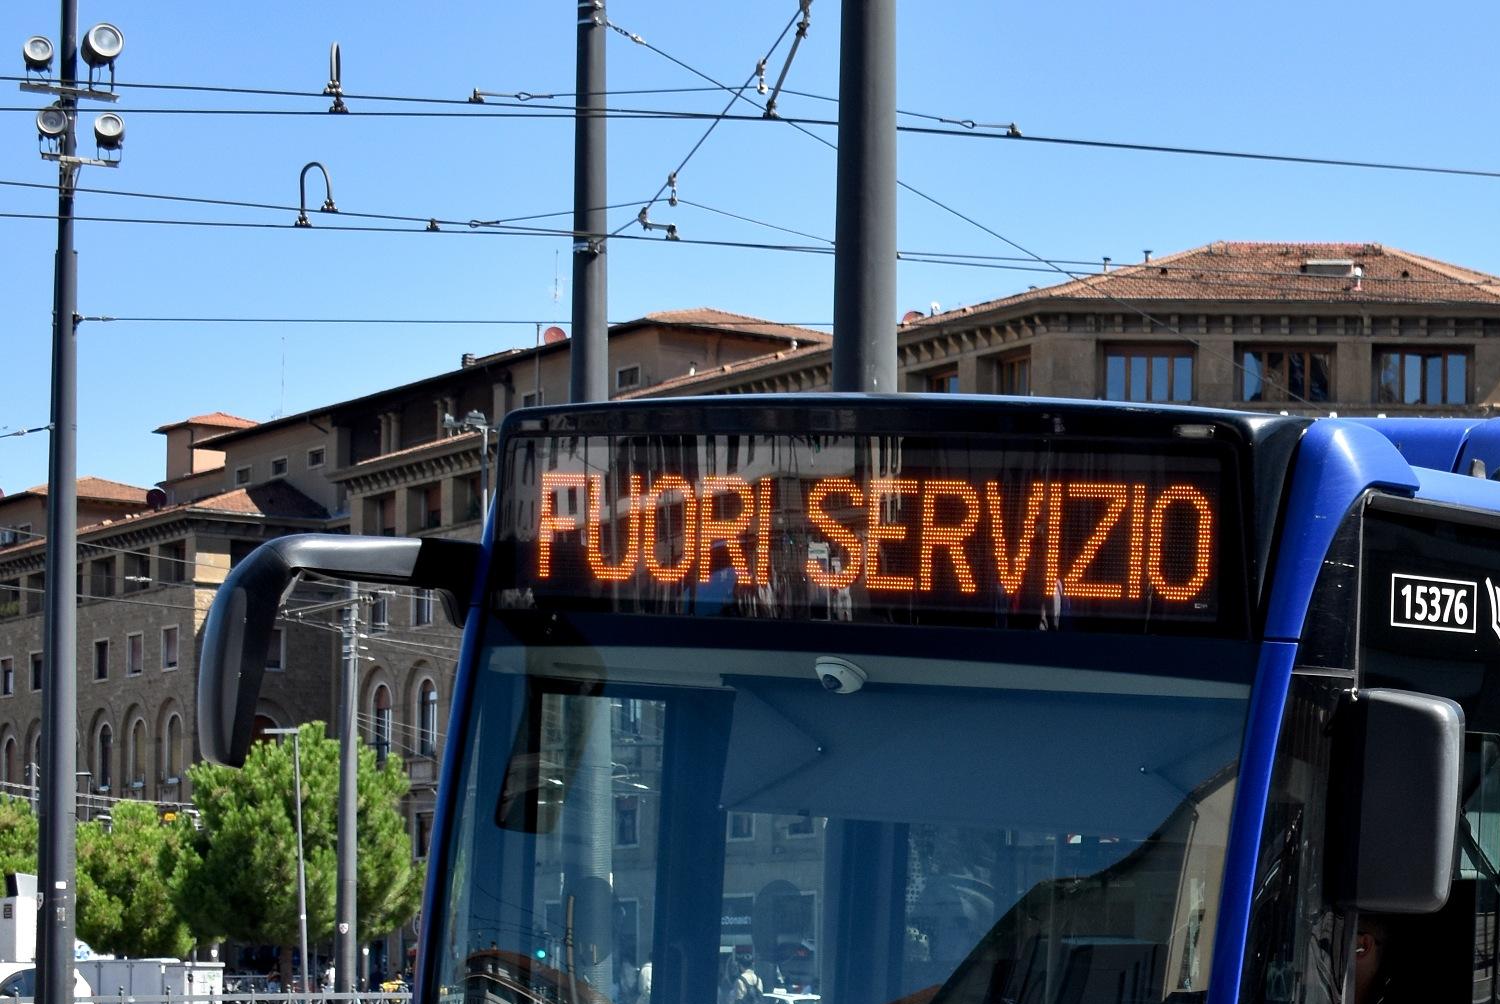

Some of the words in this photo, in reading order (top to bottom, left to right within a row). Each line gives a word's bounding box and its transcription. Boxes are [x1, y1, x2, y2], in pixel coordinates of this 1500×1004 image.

[536, 472, 773, 587] FUORI
[805, 477, 1212, 601] SERVIZIO
[1401, 584, 1468, 626] 15376
